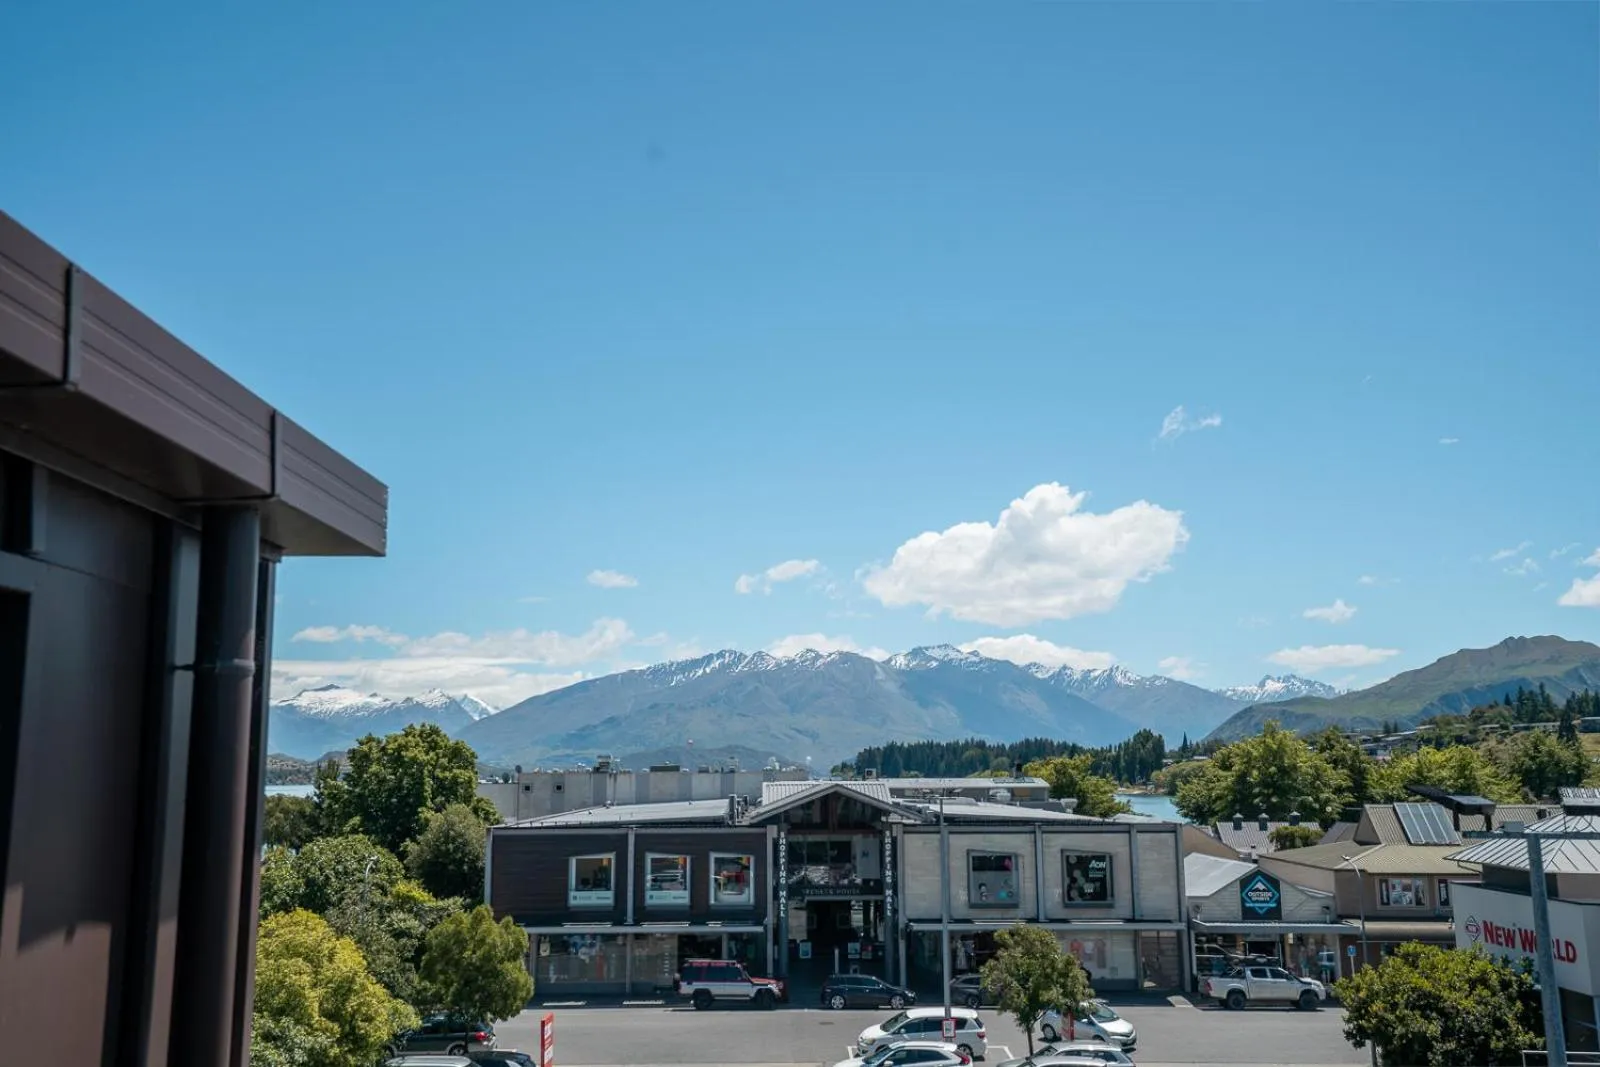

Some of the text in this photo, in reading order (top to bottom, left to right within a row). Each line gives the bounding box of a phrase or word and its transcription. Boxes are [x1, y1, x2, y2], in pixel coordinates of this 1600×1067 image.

[884, 830, 893, 917] SHOPPING MALL
[1482, 919, 1578, 964] NEW WLD
